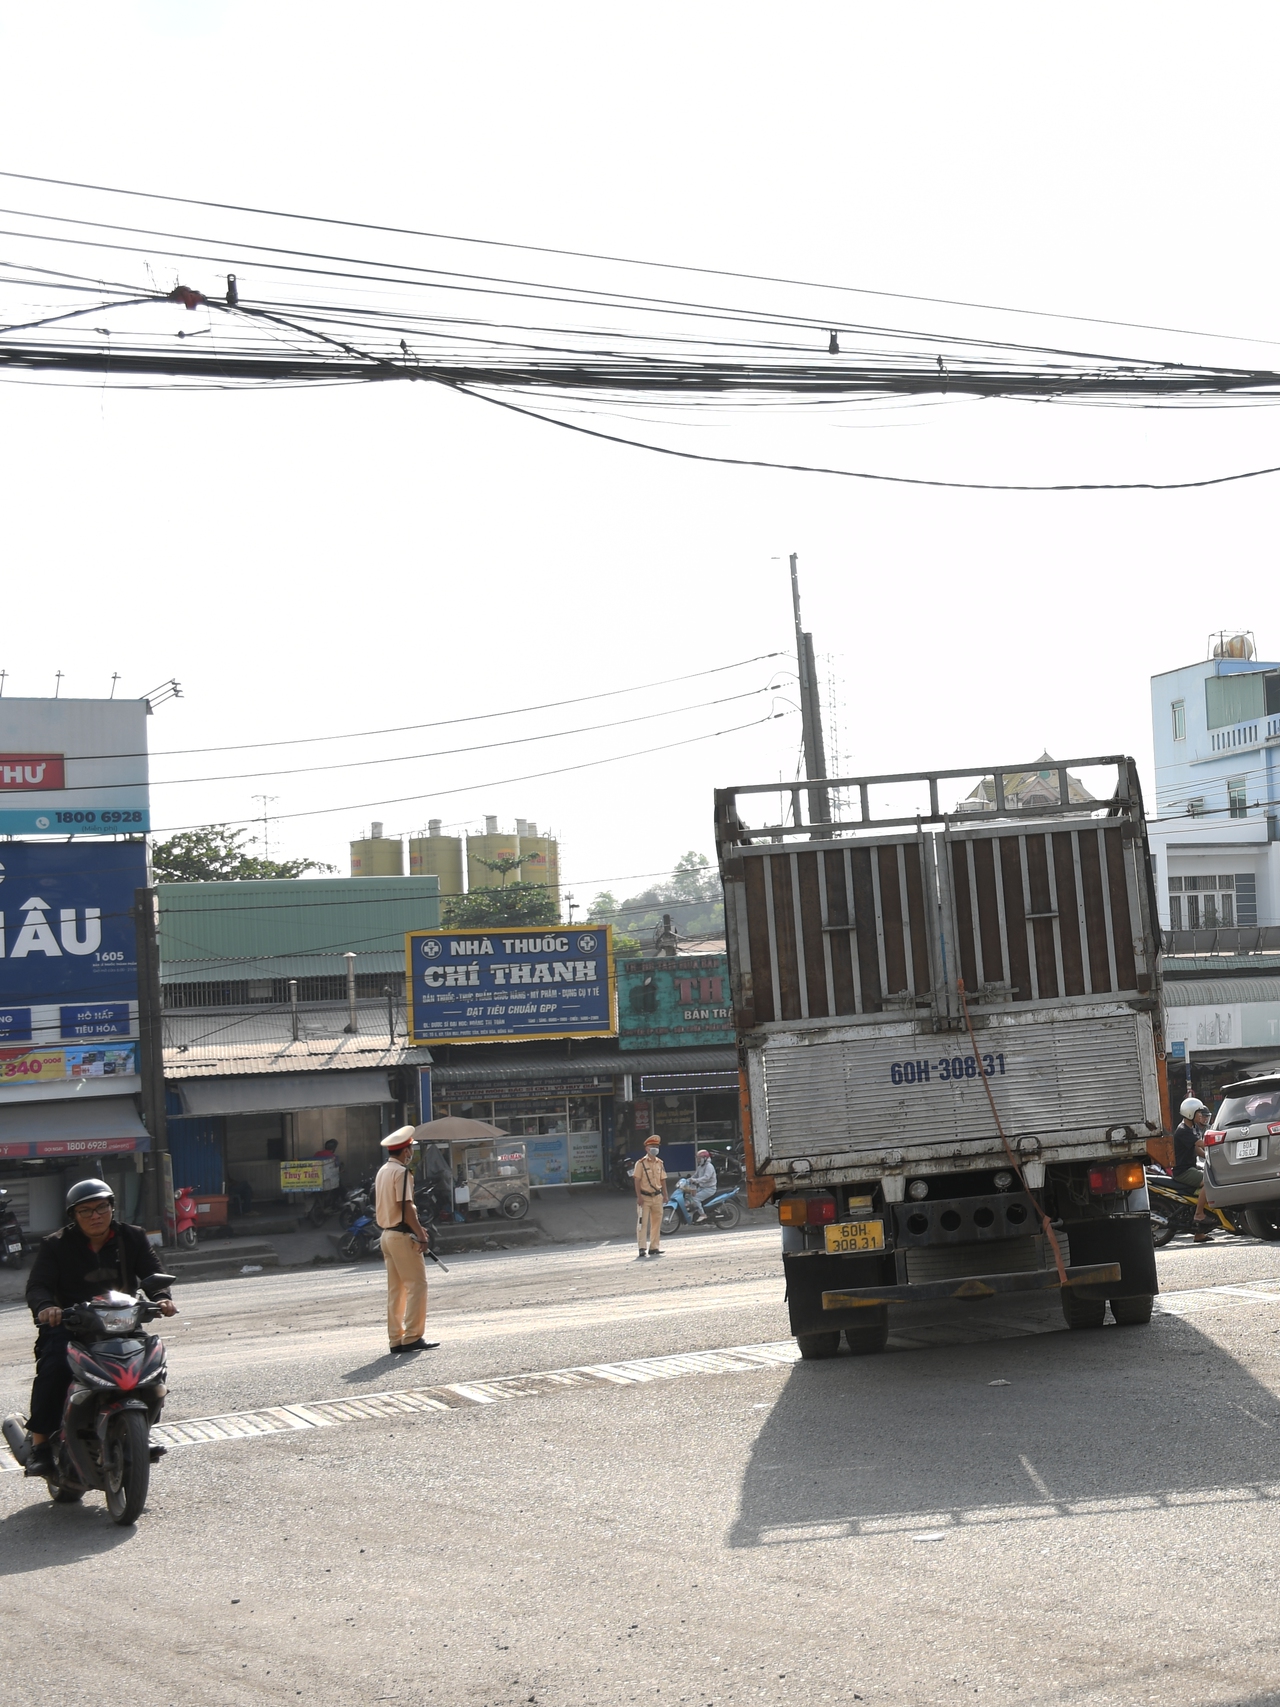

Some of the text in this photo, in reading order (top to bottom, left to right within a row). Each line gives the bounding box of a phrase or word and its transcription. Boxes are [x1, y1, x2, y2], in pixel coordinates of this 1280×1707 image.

[56, 811, 142, 823] 1800 6928
[0, 897, 102, 958] ÂU
[451, 933, 569, 956] NHÀ THUỐC
[96, 952, 124, 962] 1605
[424, 960, 597, 987] CHÍ THANH
[541, 987, 557, 998] PHẨM
[588, 988, 592, 996] Y
[593, 986, 600, 996] TẾ
[466, 1002, 557, 1017] ĐẠT TIÊU CHUẨN GPP
[684, 1008, 709, 1020] BÁN
[75, 1024, 117, 1034] TIÊU HÓA
[890, 1053, 1006, 1086] 60H-308.31
[67, 1142, 86, 1150] 1800
[88, 1141, 108, 1150] 6928
[842, 1224, 867, 1238] 60H
